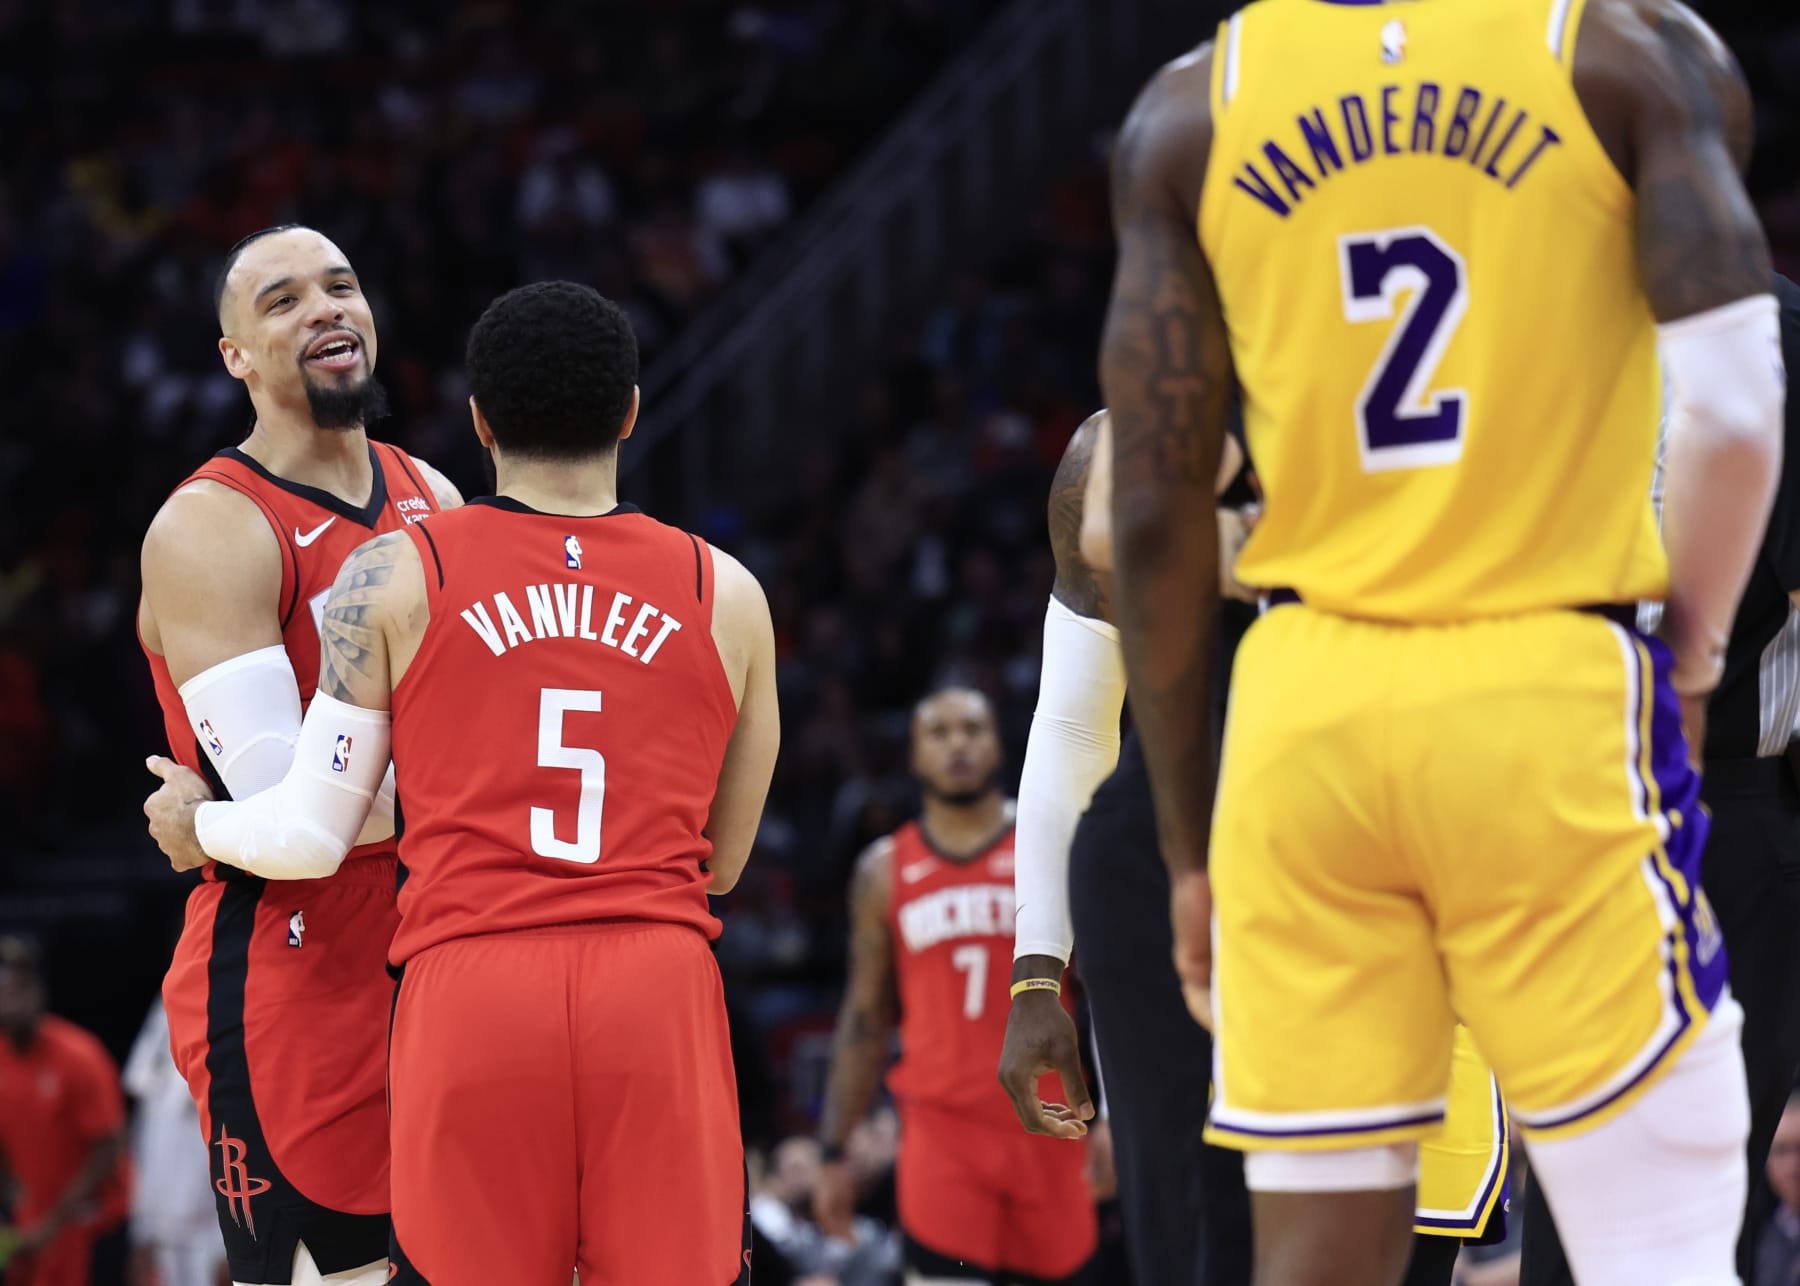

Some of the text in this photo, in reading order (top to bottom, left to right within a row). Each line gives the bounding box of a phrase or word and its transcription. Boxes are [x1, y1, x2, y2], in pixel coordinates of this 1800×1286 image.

[1233, 82, 1563, 219] VANDERBILT
[1338, 224, 1470, 474] 2
[459, 584, 682, 665] VANVLEET
[530, 688, 605, 864] 5
[952, 943, 989, 1020] 7
